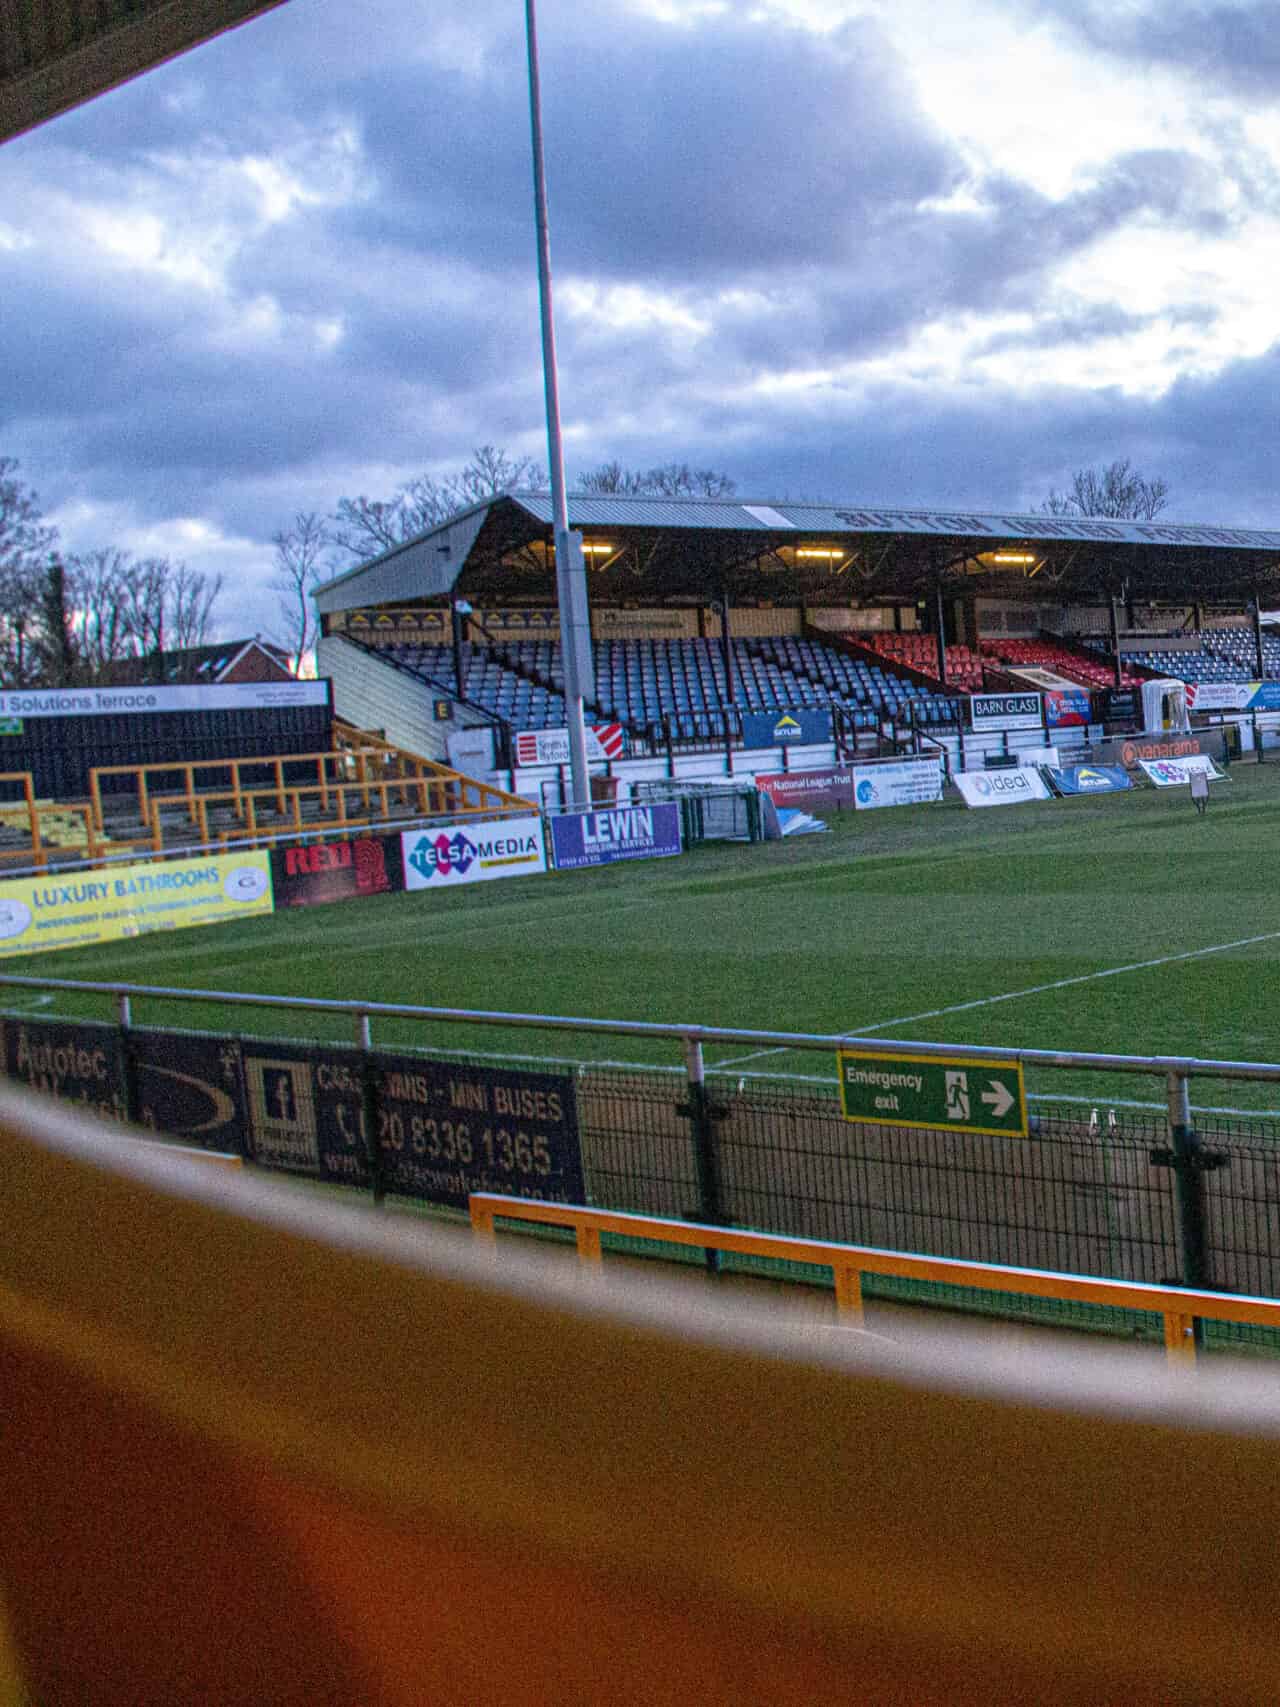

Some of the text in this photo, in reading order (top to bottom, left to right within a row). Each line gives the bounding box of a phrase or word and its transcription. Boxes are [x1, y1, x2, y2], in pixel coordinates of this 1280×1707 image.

[10, 695, 92, 712] Solutions
[95, 692, 158, 709] Terrace
[437, 702, 448, 718] E
[975, 698, 1037, 715] BARN GLASS
[1136, 739, 1201, 758] vanarama
[582, 807, 654, 844] LEWIN
[415, 842, 474, 866] TELSA
[479, 836, 538, 857] MEDIA
[32, 882, 109, 910] LUXURY
[114, 866, 220, 897] BATHROOMS
[846, 1067, 923, 1092] Emergency
[450, 1079, 488, 1112] MINI
[493, 1086, 564, 1122] BUSES
[874, 1094, 900, 1111] exit
[411, 1115, 473, 1164] 8336
[481, 1126, 552, 1177] 1365
